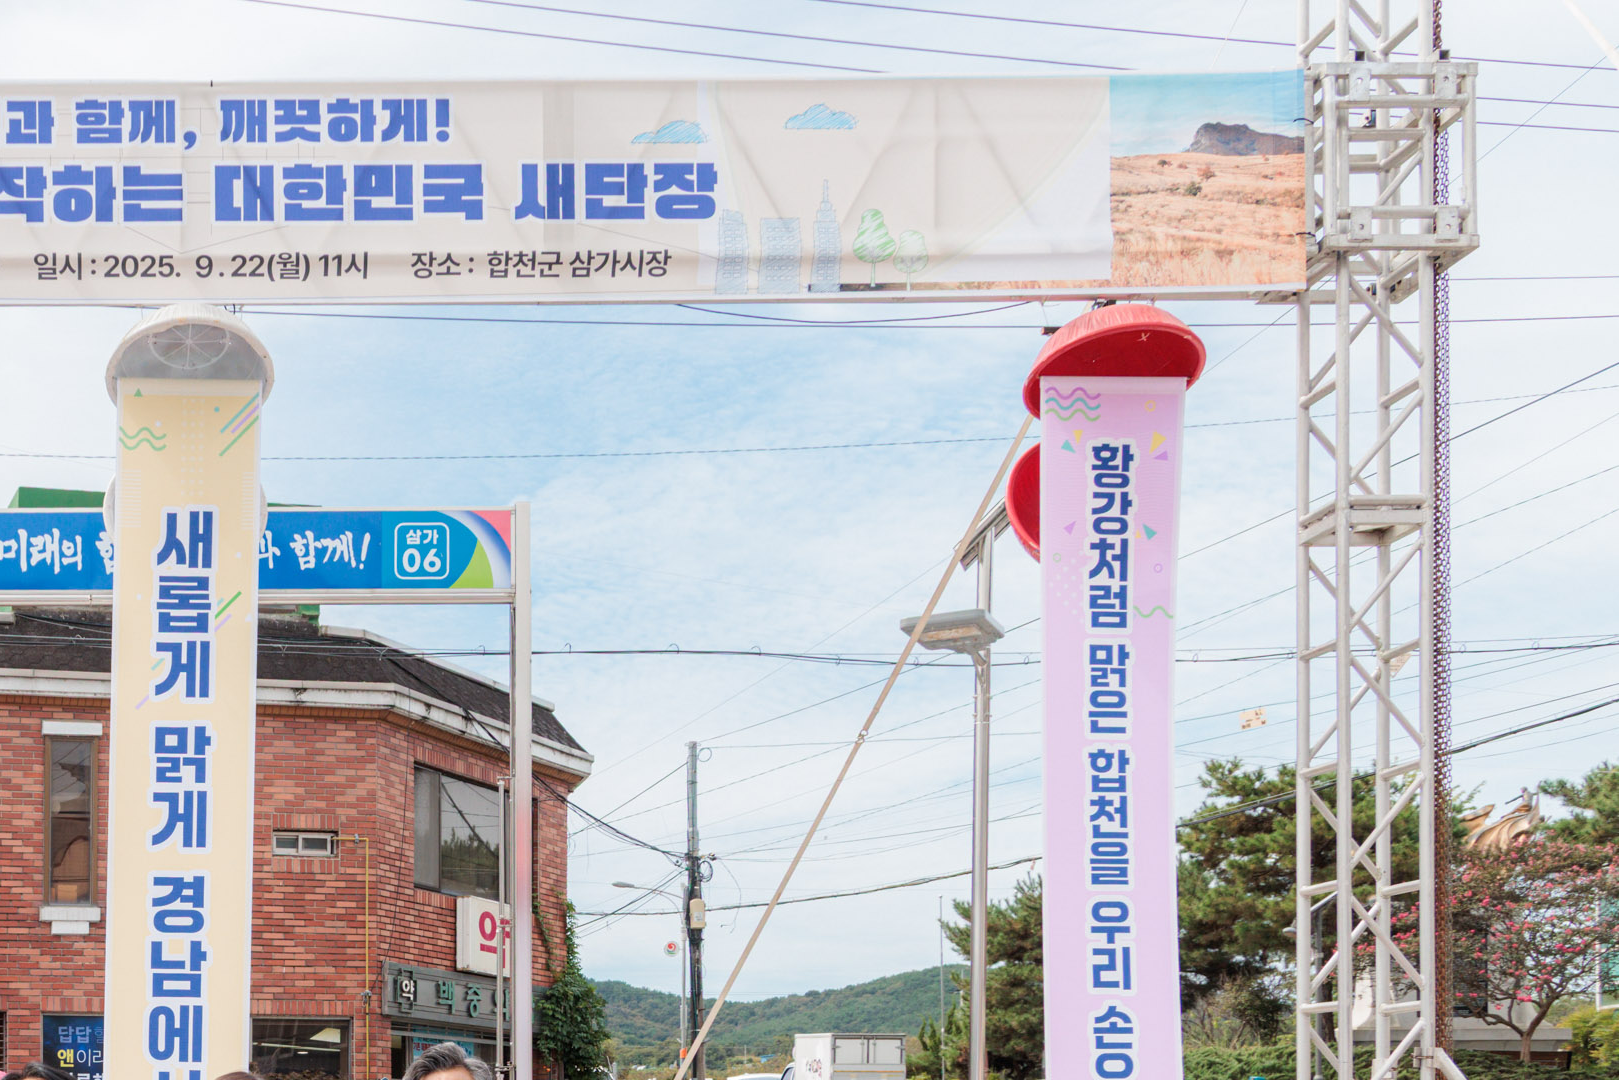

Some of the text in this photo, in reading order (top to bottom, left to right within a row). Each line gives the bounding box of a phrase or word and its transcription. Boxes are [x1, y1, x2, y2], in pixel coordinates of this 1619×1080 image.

[75, 99, 197, 150] 함께,
[219, 98, 451, 144] 깨끗하게!
[214, 163, 484, 222] 대한민국
[515, 163, 718, 221] 새단장
[103, 254, 181, 279] 2025.
[318, 252, 369, 280] 11시
[487, 251, 564, 280] 합천군
[568, 250, 672, 280] 삼가시장
[290, 530, 371, 571] 함께!
[402, 548, 443, 574] 06
[405, 529, 439, 546] 삼가
[1087, 443, 1136, 630] 황강처럼
[154, 511, 214, 698] 새롭게
[1087, 644, 1131, 735] 맑은
[151, 726, 212, 849] 맑게
[1087, 748, 1131, 886] 합천을
[1090, 900, 1132, 991] 우리
[402, 980, 415, 1001] 약
